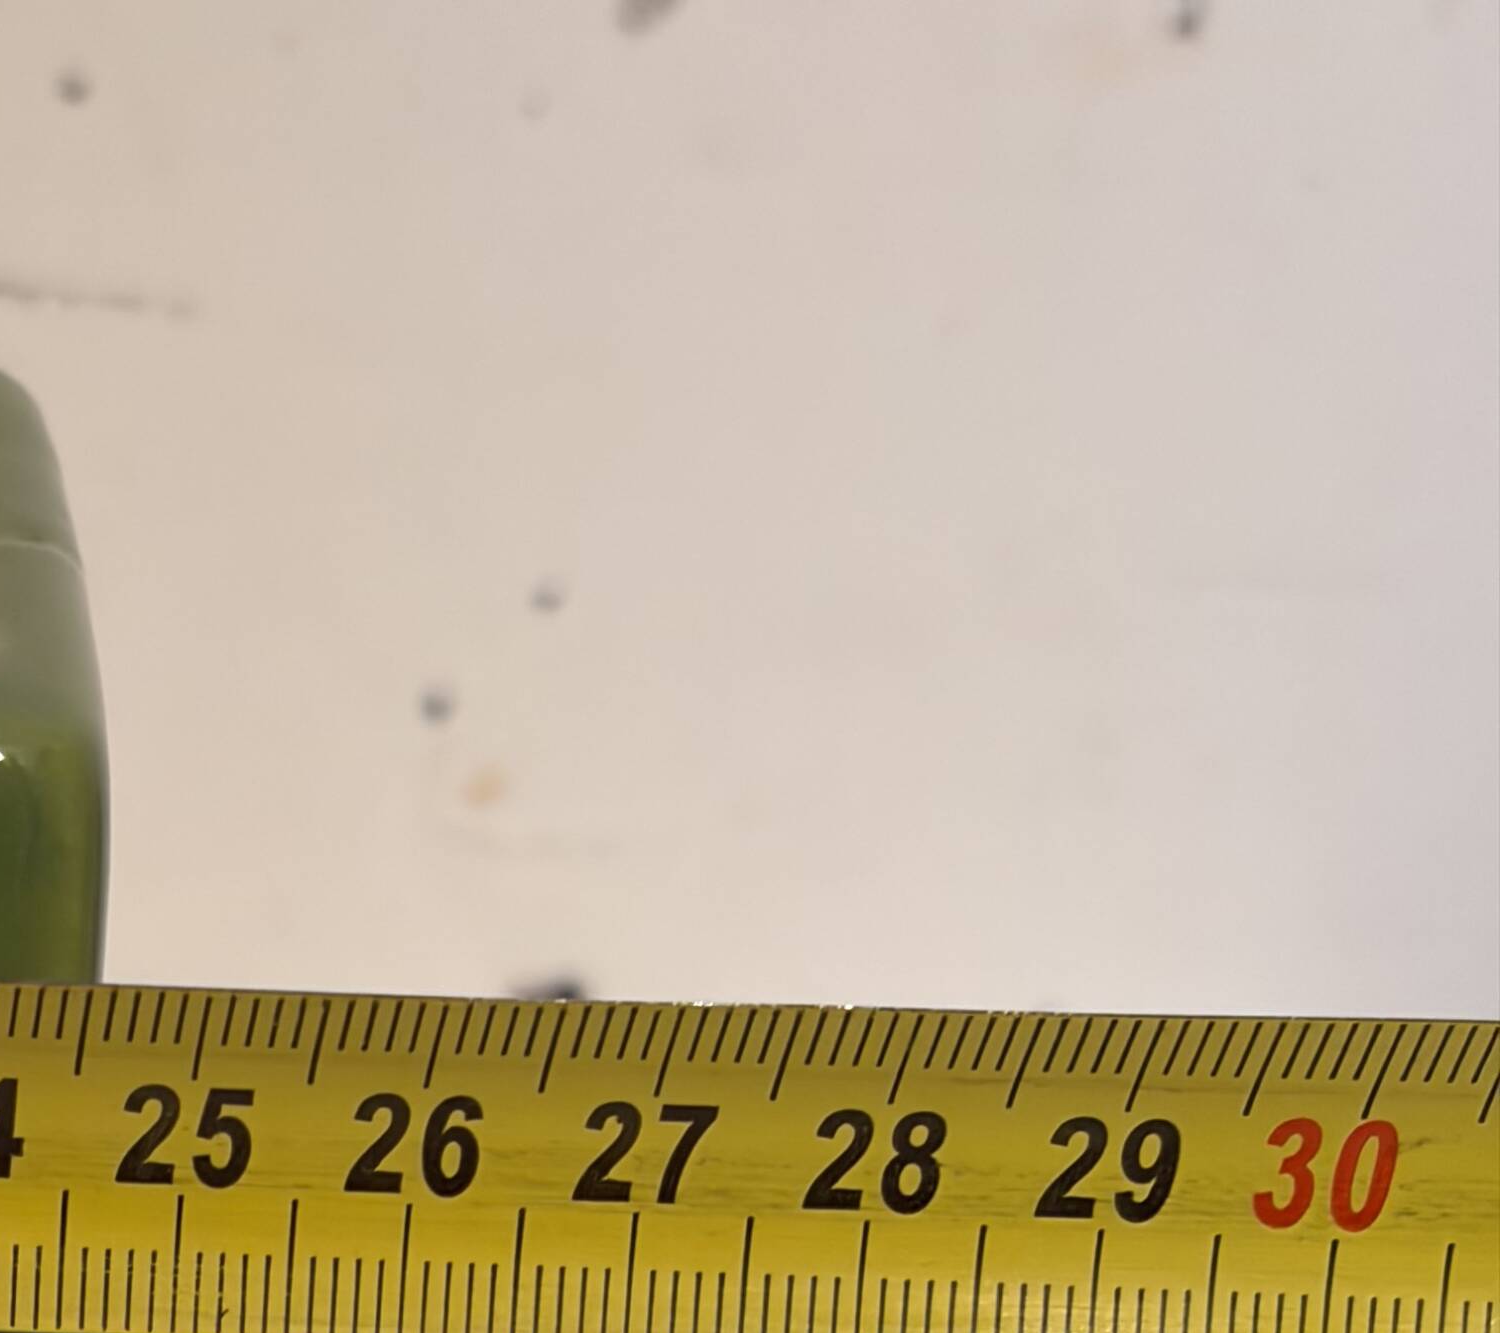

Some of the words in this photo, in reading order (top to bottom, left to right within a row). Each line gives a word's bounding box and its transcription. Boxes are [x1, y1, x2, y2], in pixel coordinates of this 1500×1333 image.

[114, 1084, 255, 1189] 25
[343, 1092, 484, 1198] 26
[571, 1100, 719, 1204] 27
[801, 1108, 948, 1215] 28
[1033, 1116, 1182, 1224] 29
[1252, 1117, 1399, 1233] 30
